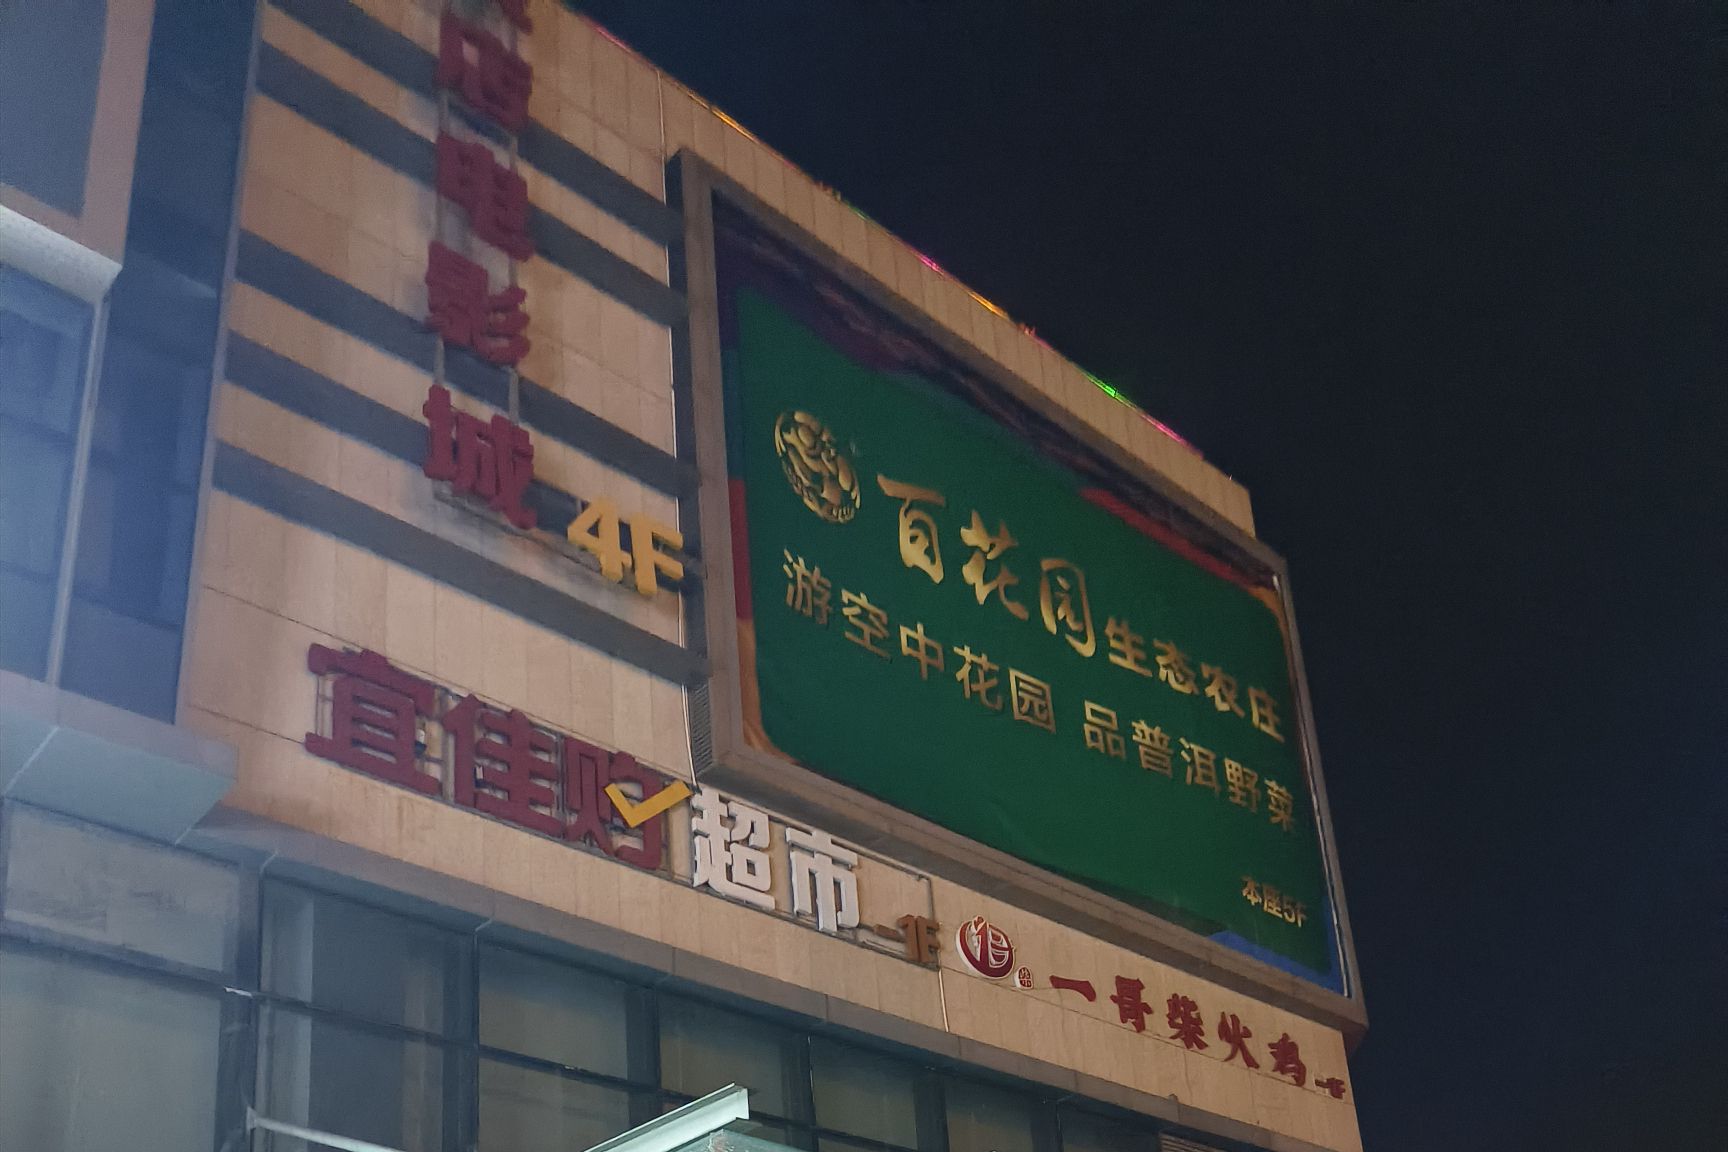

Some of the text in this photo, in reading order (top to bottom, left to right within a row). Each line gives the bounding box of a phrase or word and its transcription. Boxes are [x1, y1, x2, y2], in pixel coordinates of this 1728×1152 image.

[567, 499, 685, 598] 4F
[782, 548, 1295, 832] 游空中花园 品普洱野菜
[1049, 974, 1307, 1088] 一哥柴火鸡
